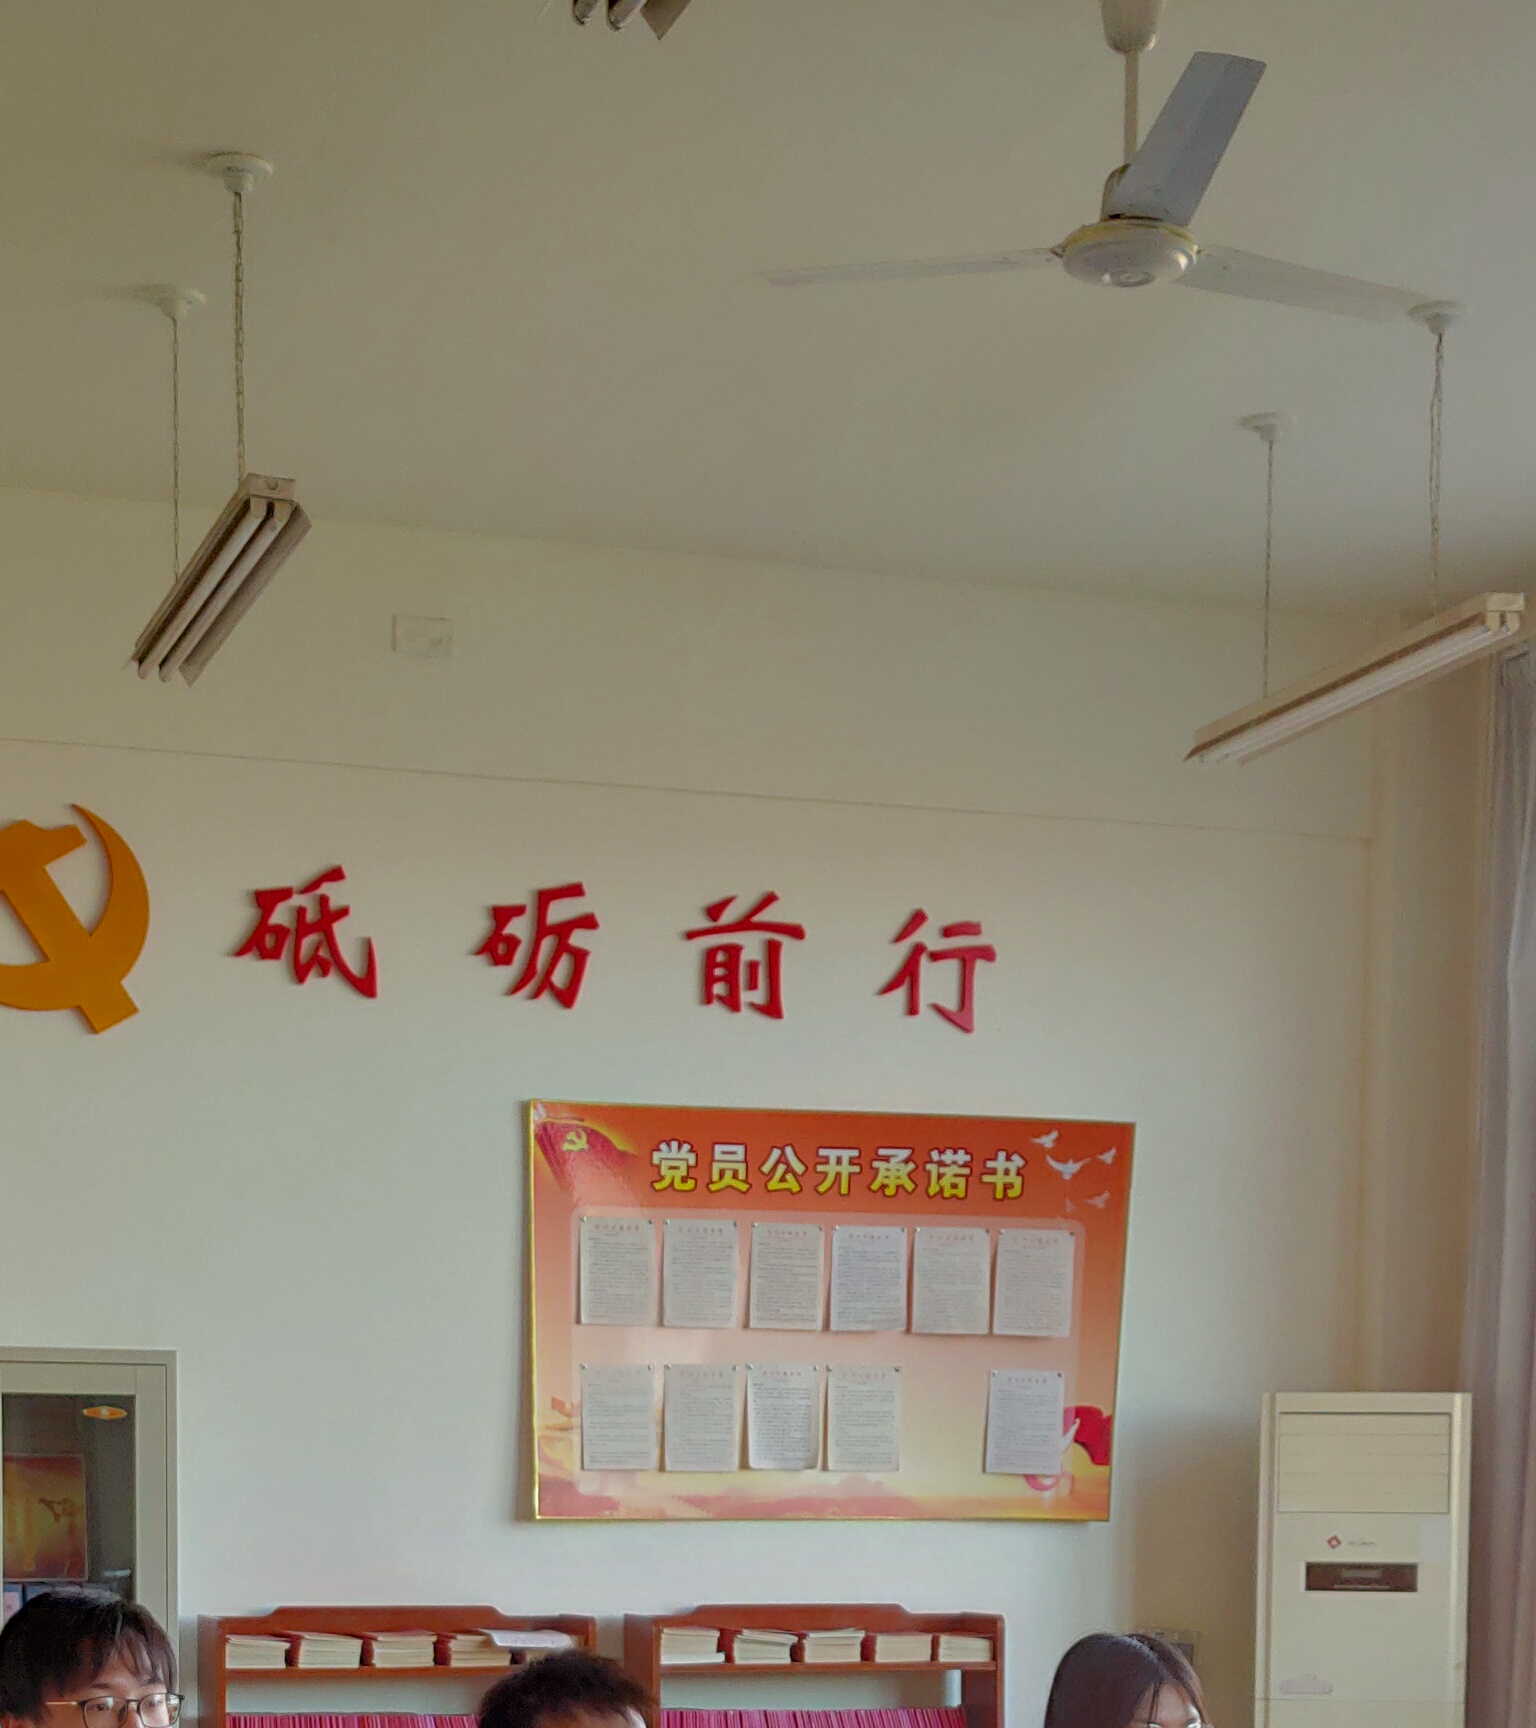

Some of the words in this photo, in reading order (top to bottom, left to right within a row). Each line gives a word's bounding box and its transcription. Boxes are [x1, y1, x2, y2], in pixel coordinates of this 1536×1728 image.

[234, 864, 997, 1032] 砥砺前行
[649, 1139, 1027, 1201] 党员公开承诺书
